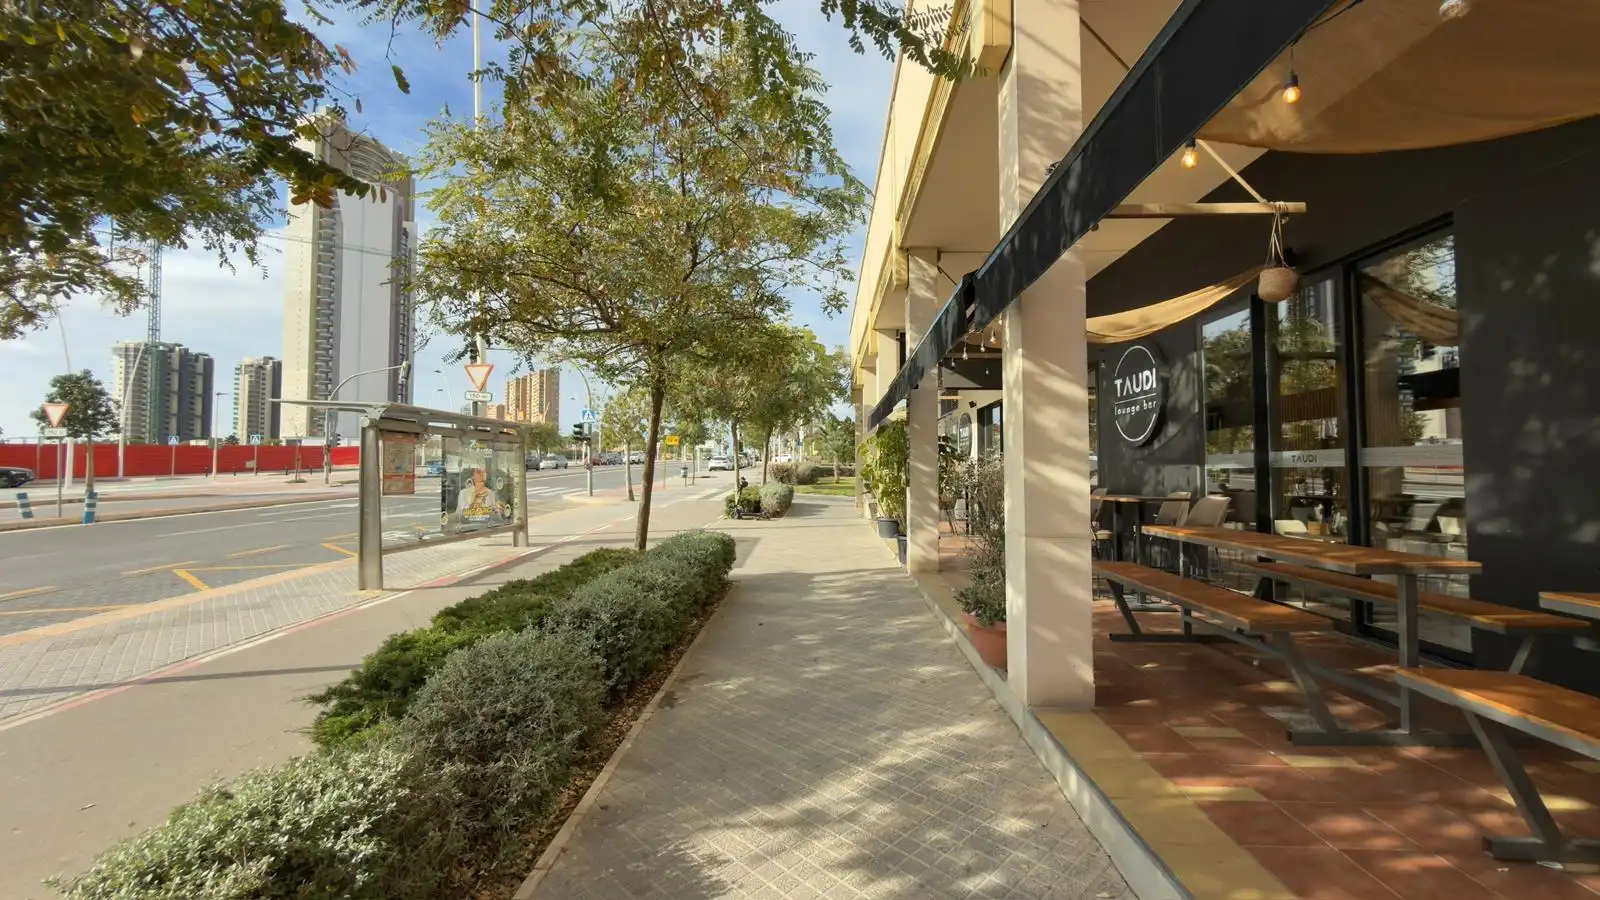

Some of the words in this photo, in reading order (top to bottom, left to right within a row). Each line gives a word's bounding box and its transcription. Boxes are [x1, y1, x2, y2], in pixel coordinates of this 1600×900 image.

[1114, 368, 1157, 397] TAUDI
[1115, 404, 1140, 415] lounge
[1143, 400, 1157, 410] bar
[1291, 454, 1317, 464] TAUDI
